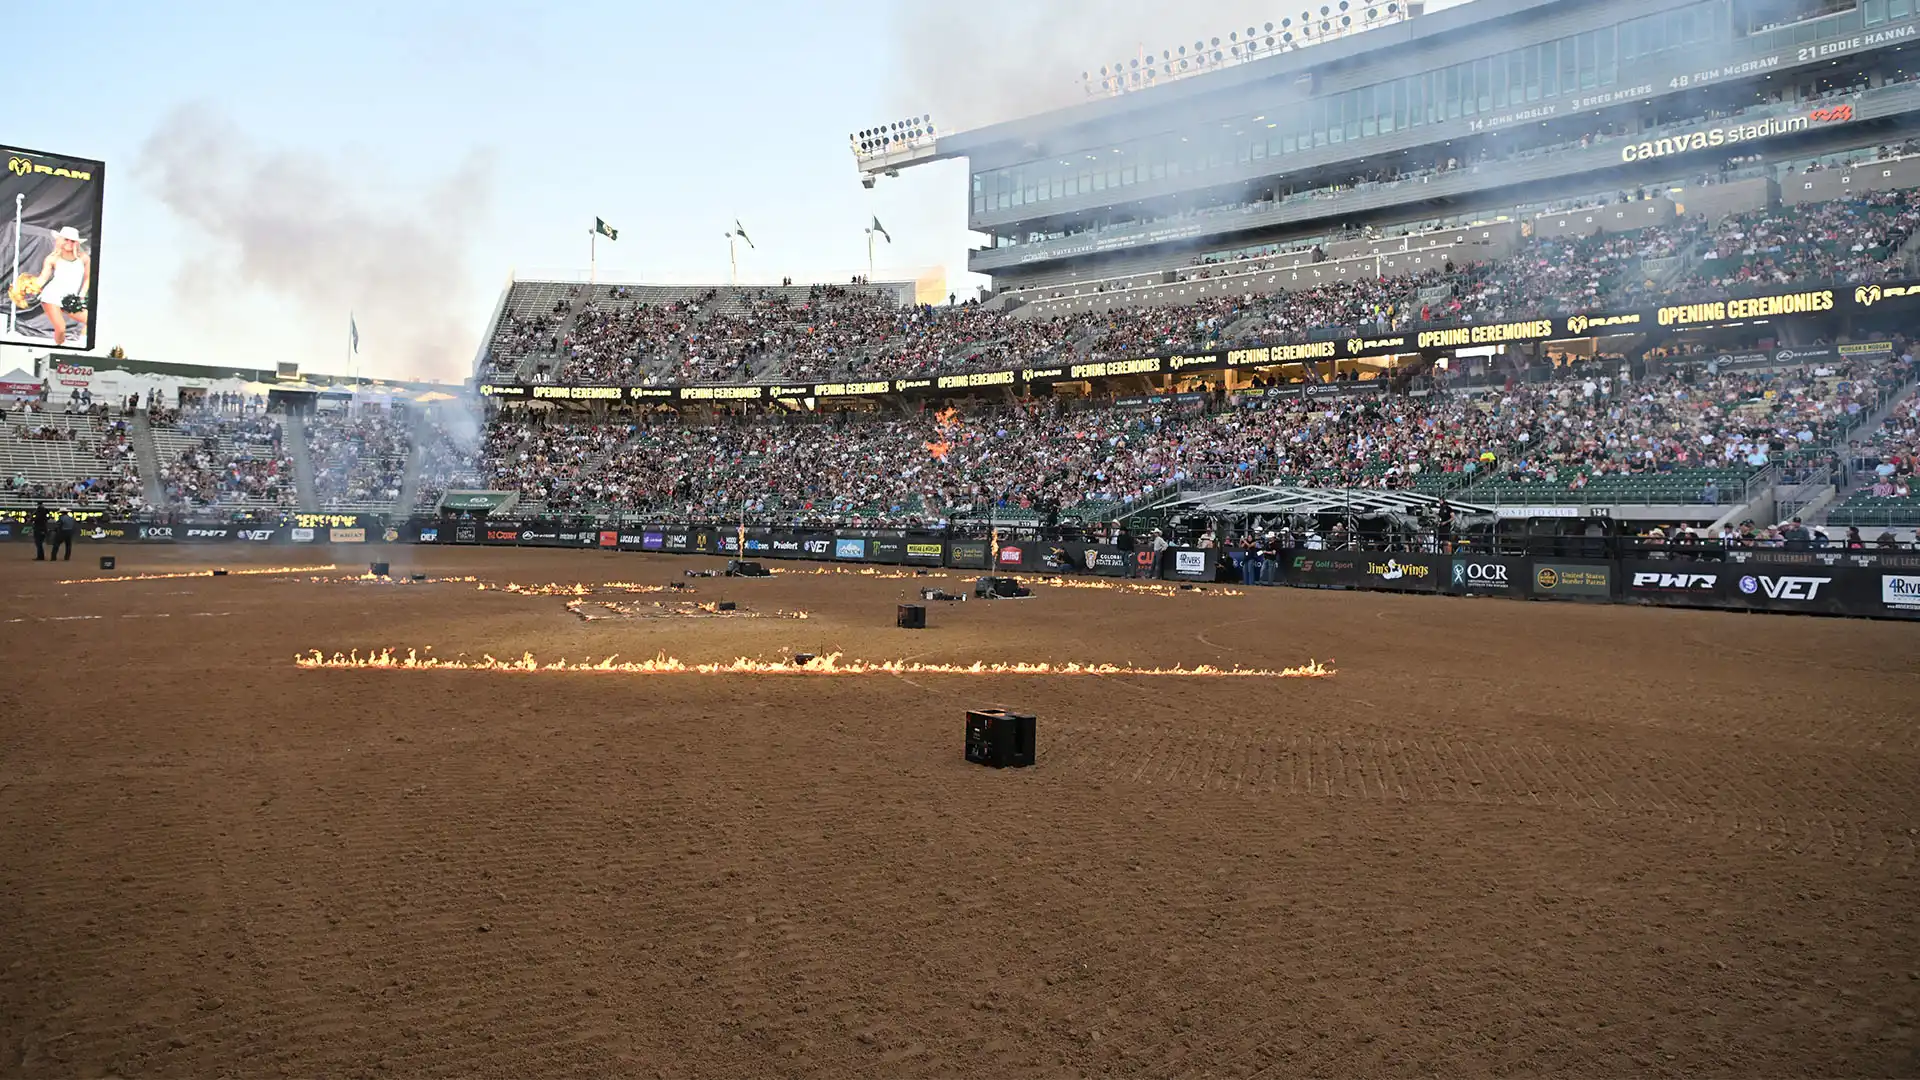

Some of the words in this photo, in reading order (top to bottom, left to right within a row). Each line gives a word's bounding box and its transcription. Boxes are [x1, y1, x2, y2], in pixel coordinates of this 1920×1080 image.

[1798, 46, 1816, 61] 21
[1820, 38, 1861, 56] EDDIE
[1865, 25, 1916, 48] HANNA
[1669, 75, 1688, 88] 48
[1693, 69, 1719, 83] FUM
[1723, 56, 1779, 77] McGRAW
[1571, 99, 1580, 112] 3
[1583, 93, 1611, 106] GREG
[1614, 84, 1652, 100] MYERS
[1470, 119, 1484, 132] 14
[1487, 114, 1513, 128] JOHN
[1515, 105, 1555, 120] MOSLEY
[1622, 128, 1725, 162] canvas
[1727, 115, 1809, 144] stadium
[34, 165, 91, 181] RAM
[1589, 314, 1640, 326] RAM
[1658, 302, 1725, 326] OPENING
[1727, 290, 1834, 319] CEREMONIES
[1364, 338, 1404, 348] RAM
[1418, 330, 1470, 348] OPENING
[1471, 320, 1552, 343] CEREMONIES
[1184, 356, 1216, 364] RAM
[1228, 348, 1270, 365] OPENING
[1270, 342, 1336, 360] CEREMONIES
[57, 363, 93, 375] Coors
[1071, 362, 1106, 378] OPENING
[1106, 358, 1160, 375] CEREMONIES
[906, 380, 930, 388] RAM
[938, 374, 968, 388] OPENING
[969, 371, 1014, 386] CEREMONIES
[533, 387, 569, 398] OPENING
[571, 387, 622, 398] CEREMONIES
[680, 388, 714, 399] OPENING
[714, 387, 761, 398] CEREMONIES
[814, 384, 845, 395] OPENING
[846, 382, 889, 394] CEREMONIES
[148, 528, 172, 536] OCR
[246, 530, 274, 540] VET
[810, 541, 830, 553] VET
[1315, 560, 1331, 569] Golf
[1334, 561, 1353, 570] Sport
[1367, 562, 1389, 575] Jim's
[1399, 563, 1428, 578] Wings
[1467, 563, 1508, 581] OCR
[1585, 572, 1605, 580] States
[1758, 575, 1832, 600] VET
